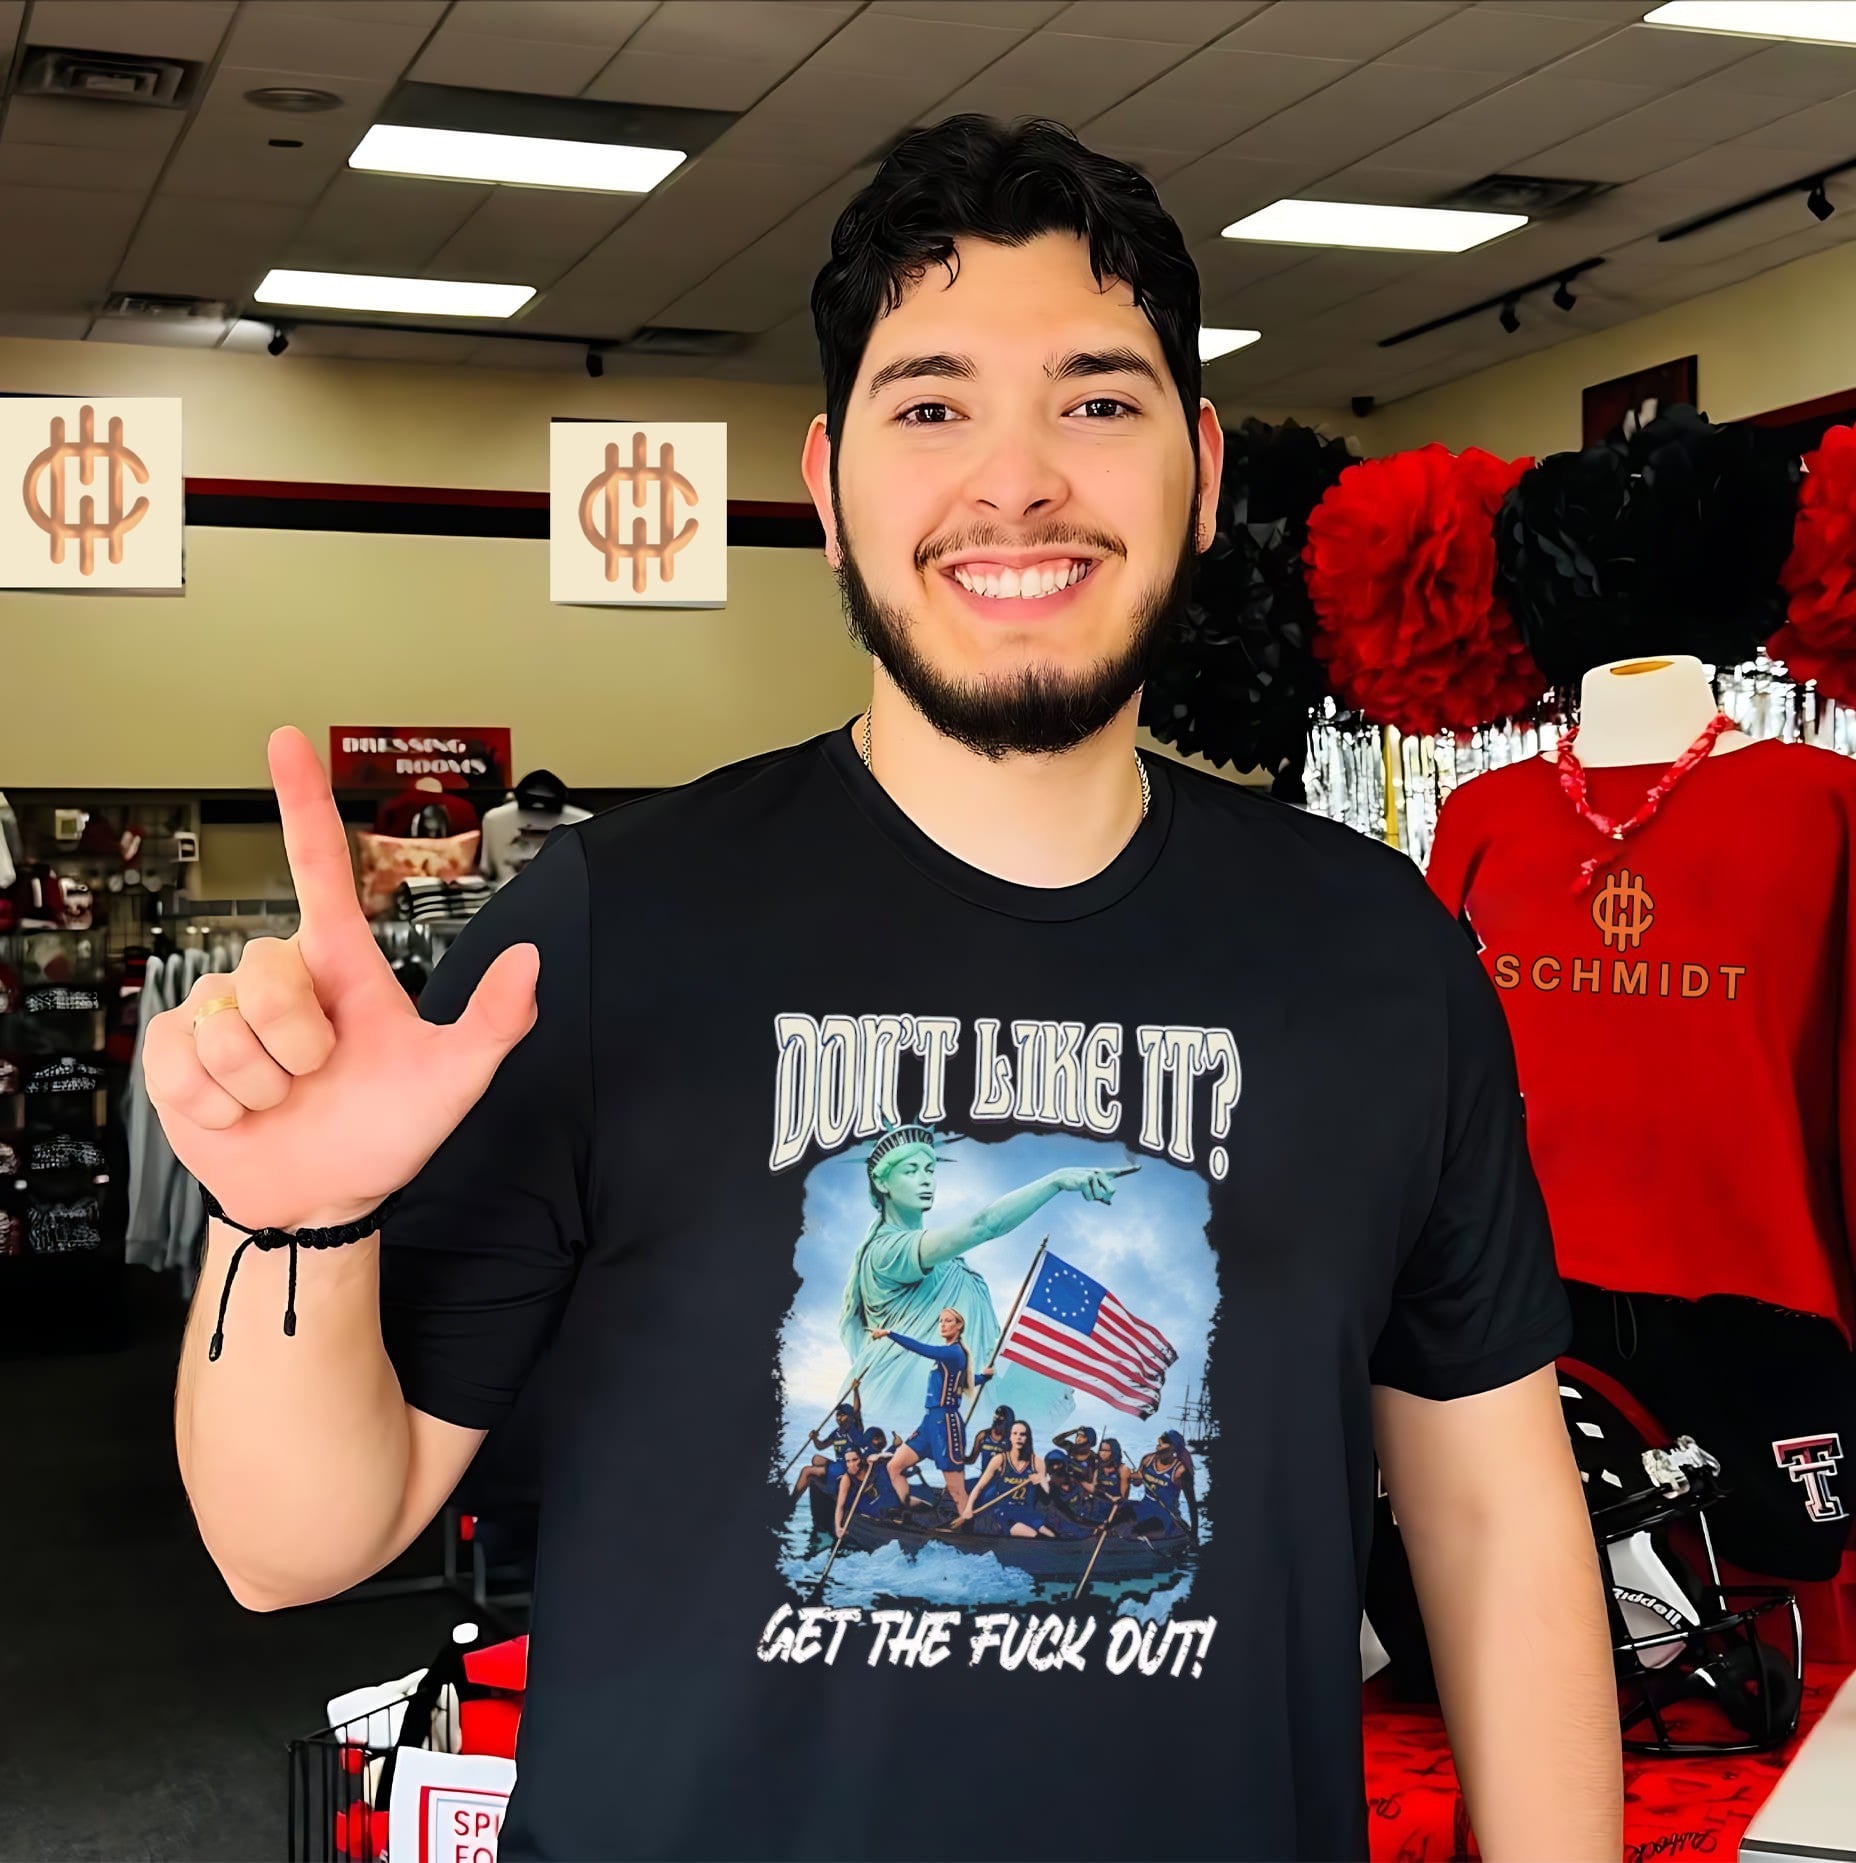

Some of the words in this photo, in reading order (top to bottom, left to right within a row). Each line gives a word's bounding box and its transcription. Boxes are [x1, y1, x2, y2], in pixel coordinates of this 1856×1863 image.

[342, 737, 467, 754] DRESSING
[396, 758, 489, 775] ROOMS
[1494, 953, 1747, 1001] SCHMIDT
[768, 1013, 961, 1172] DON'T
[970, 1019, 1123, 1134] LIKE
[1136, 1024, 1243, 1181] IT?
[756, 1602, 863, 1666] GET
[867, 1609, 962, 1669] THE
[968, 1611, 1098, 1673] FUCK
[1104, 1615, 1219, 1680] OUT!
